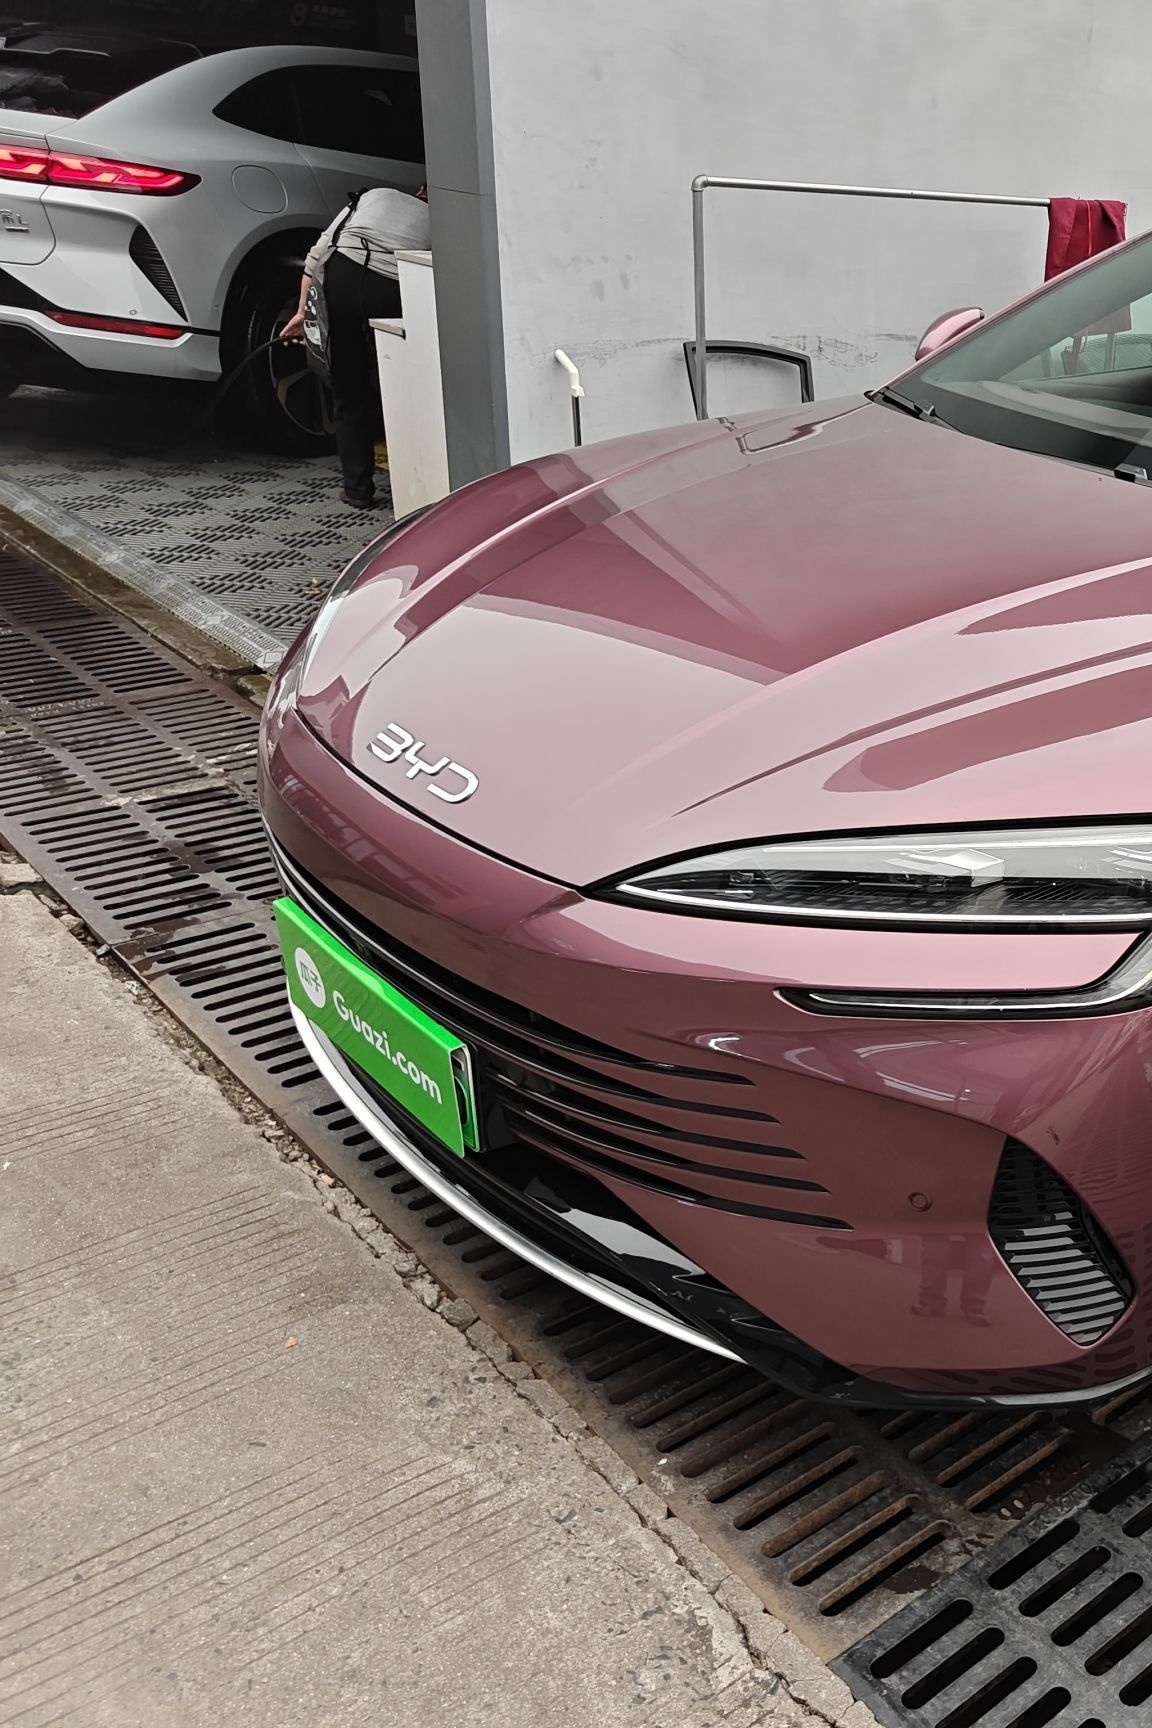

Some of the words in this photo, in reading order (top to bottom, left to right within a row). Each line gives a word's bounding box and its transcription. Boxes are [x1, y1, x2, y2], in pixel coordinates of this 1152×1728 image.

[367, 722, 480, 804] BYD
[299, 960, 322, 993] 瓜子
[332, 990, 443, 1105] Guazi.com
